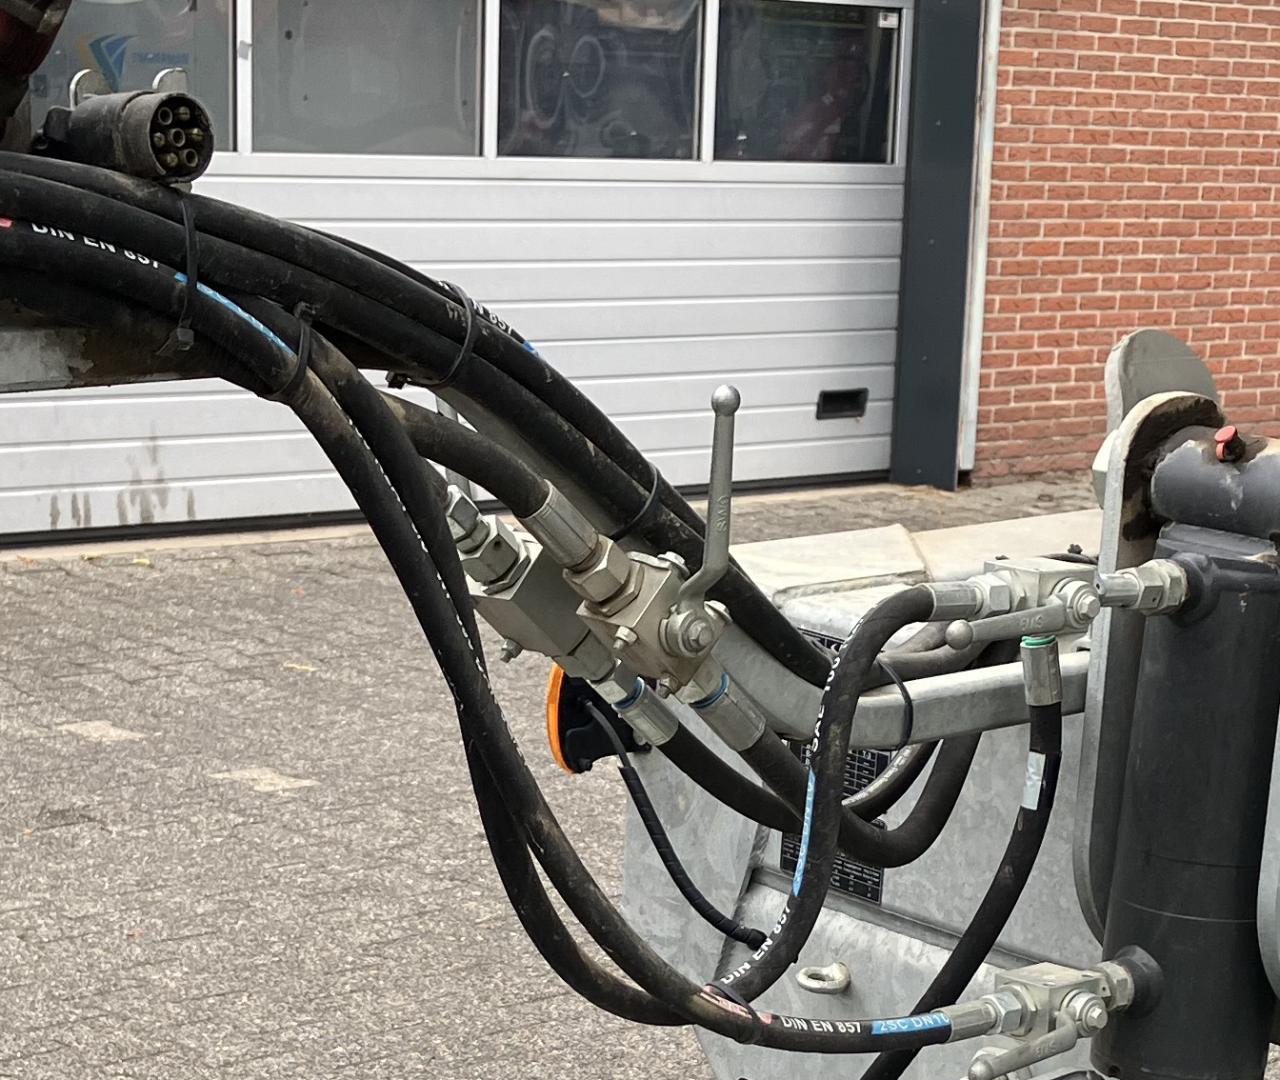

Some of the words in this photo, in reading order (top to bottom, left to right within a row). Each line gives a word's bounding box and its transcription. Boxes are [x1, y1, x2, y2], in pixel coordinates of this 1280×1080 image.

[782, 1015, 809, 1031] DIN
[812, 1020, 835, 1033] EN
[838, 1021, 863, 1034] 857
[879, 1019, 909, 1033] 2SC
